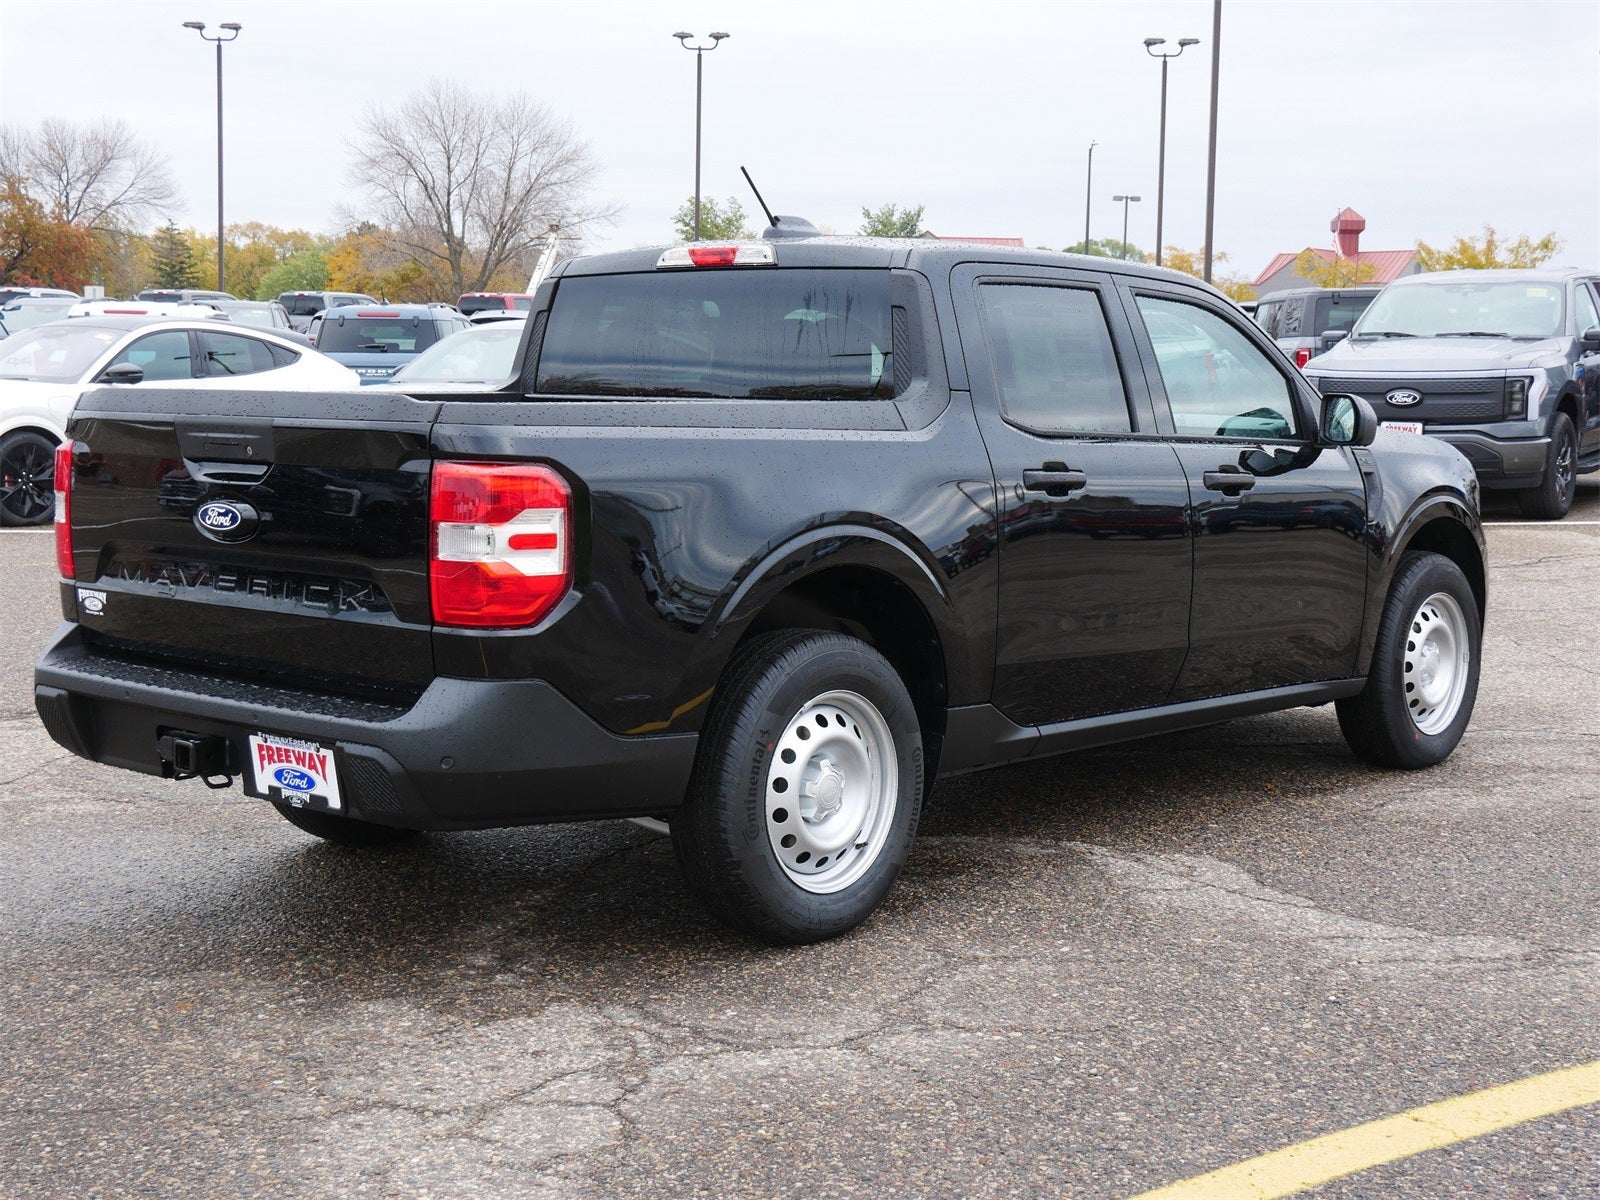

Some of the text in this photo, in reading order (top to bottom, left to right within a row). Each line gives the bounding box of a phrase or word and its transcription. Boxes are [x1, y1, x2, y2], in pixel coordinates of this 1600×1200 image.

[1391, 392, 1414, 403] Ford
[205, 507, 232, 526] Ford
[117, 566, 375, 613] MAVERICK
[257, 743, 329, 786] FREEWAY
[281, 769, 309, 789] Ford
[281, 788, 310, 804] FREEWAY
